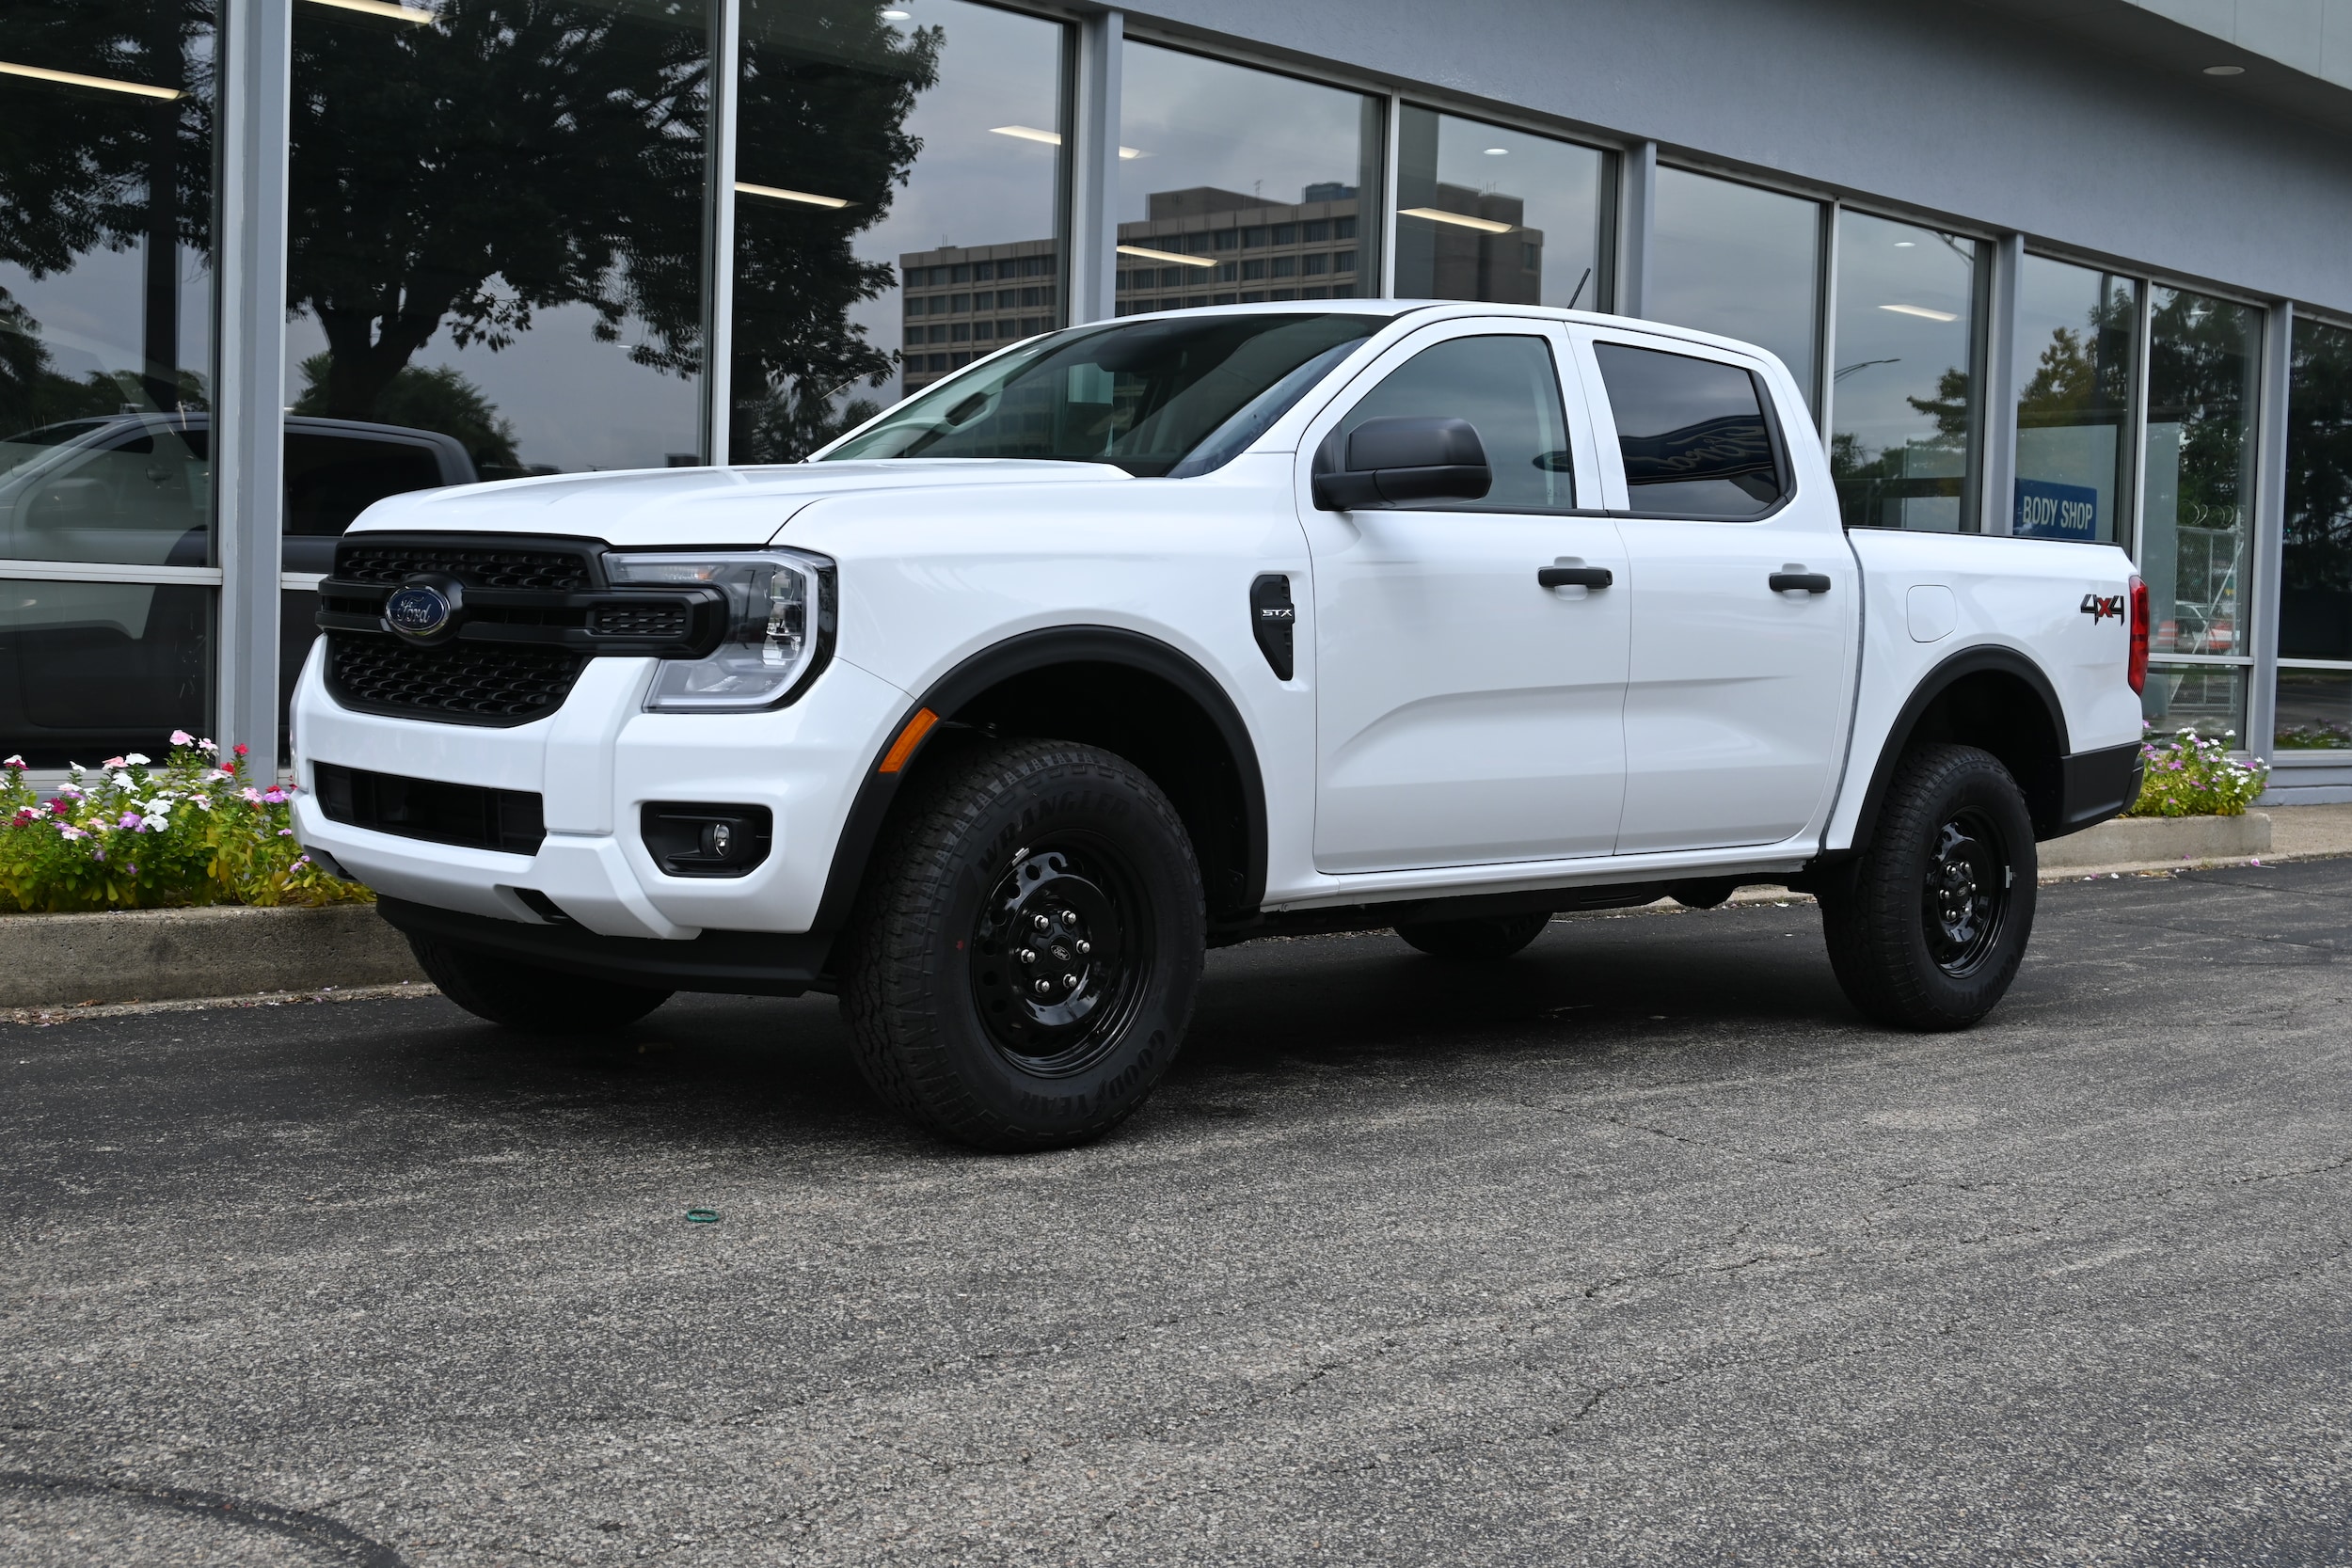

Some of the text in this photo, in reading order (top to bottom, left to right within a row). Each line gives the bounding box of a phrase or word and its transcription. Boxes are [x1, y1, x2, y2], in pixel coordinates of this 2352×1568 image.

[2023, 496, 2093, 530] BODY SHOP
[396, 594, 432, 623] Ford
[1262, 609, 1292, 617] STX
[977, 790, 1131, 874] WRANGLER
[1020, 1029, 1166, 1119] GOODYEAR
